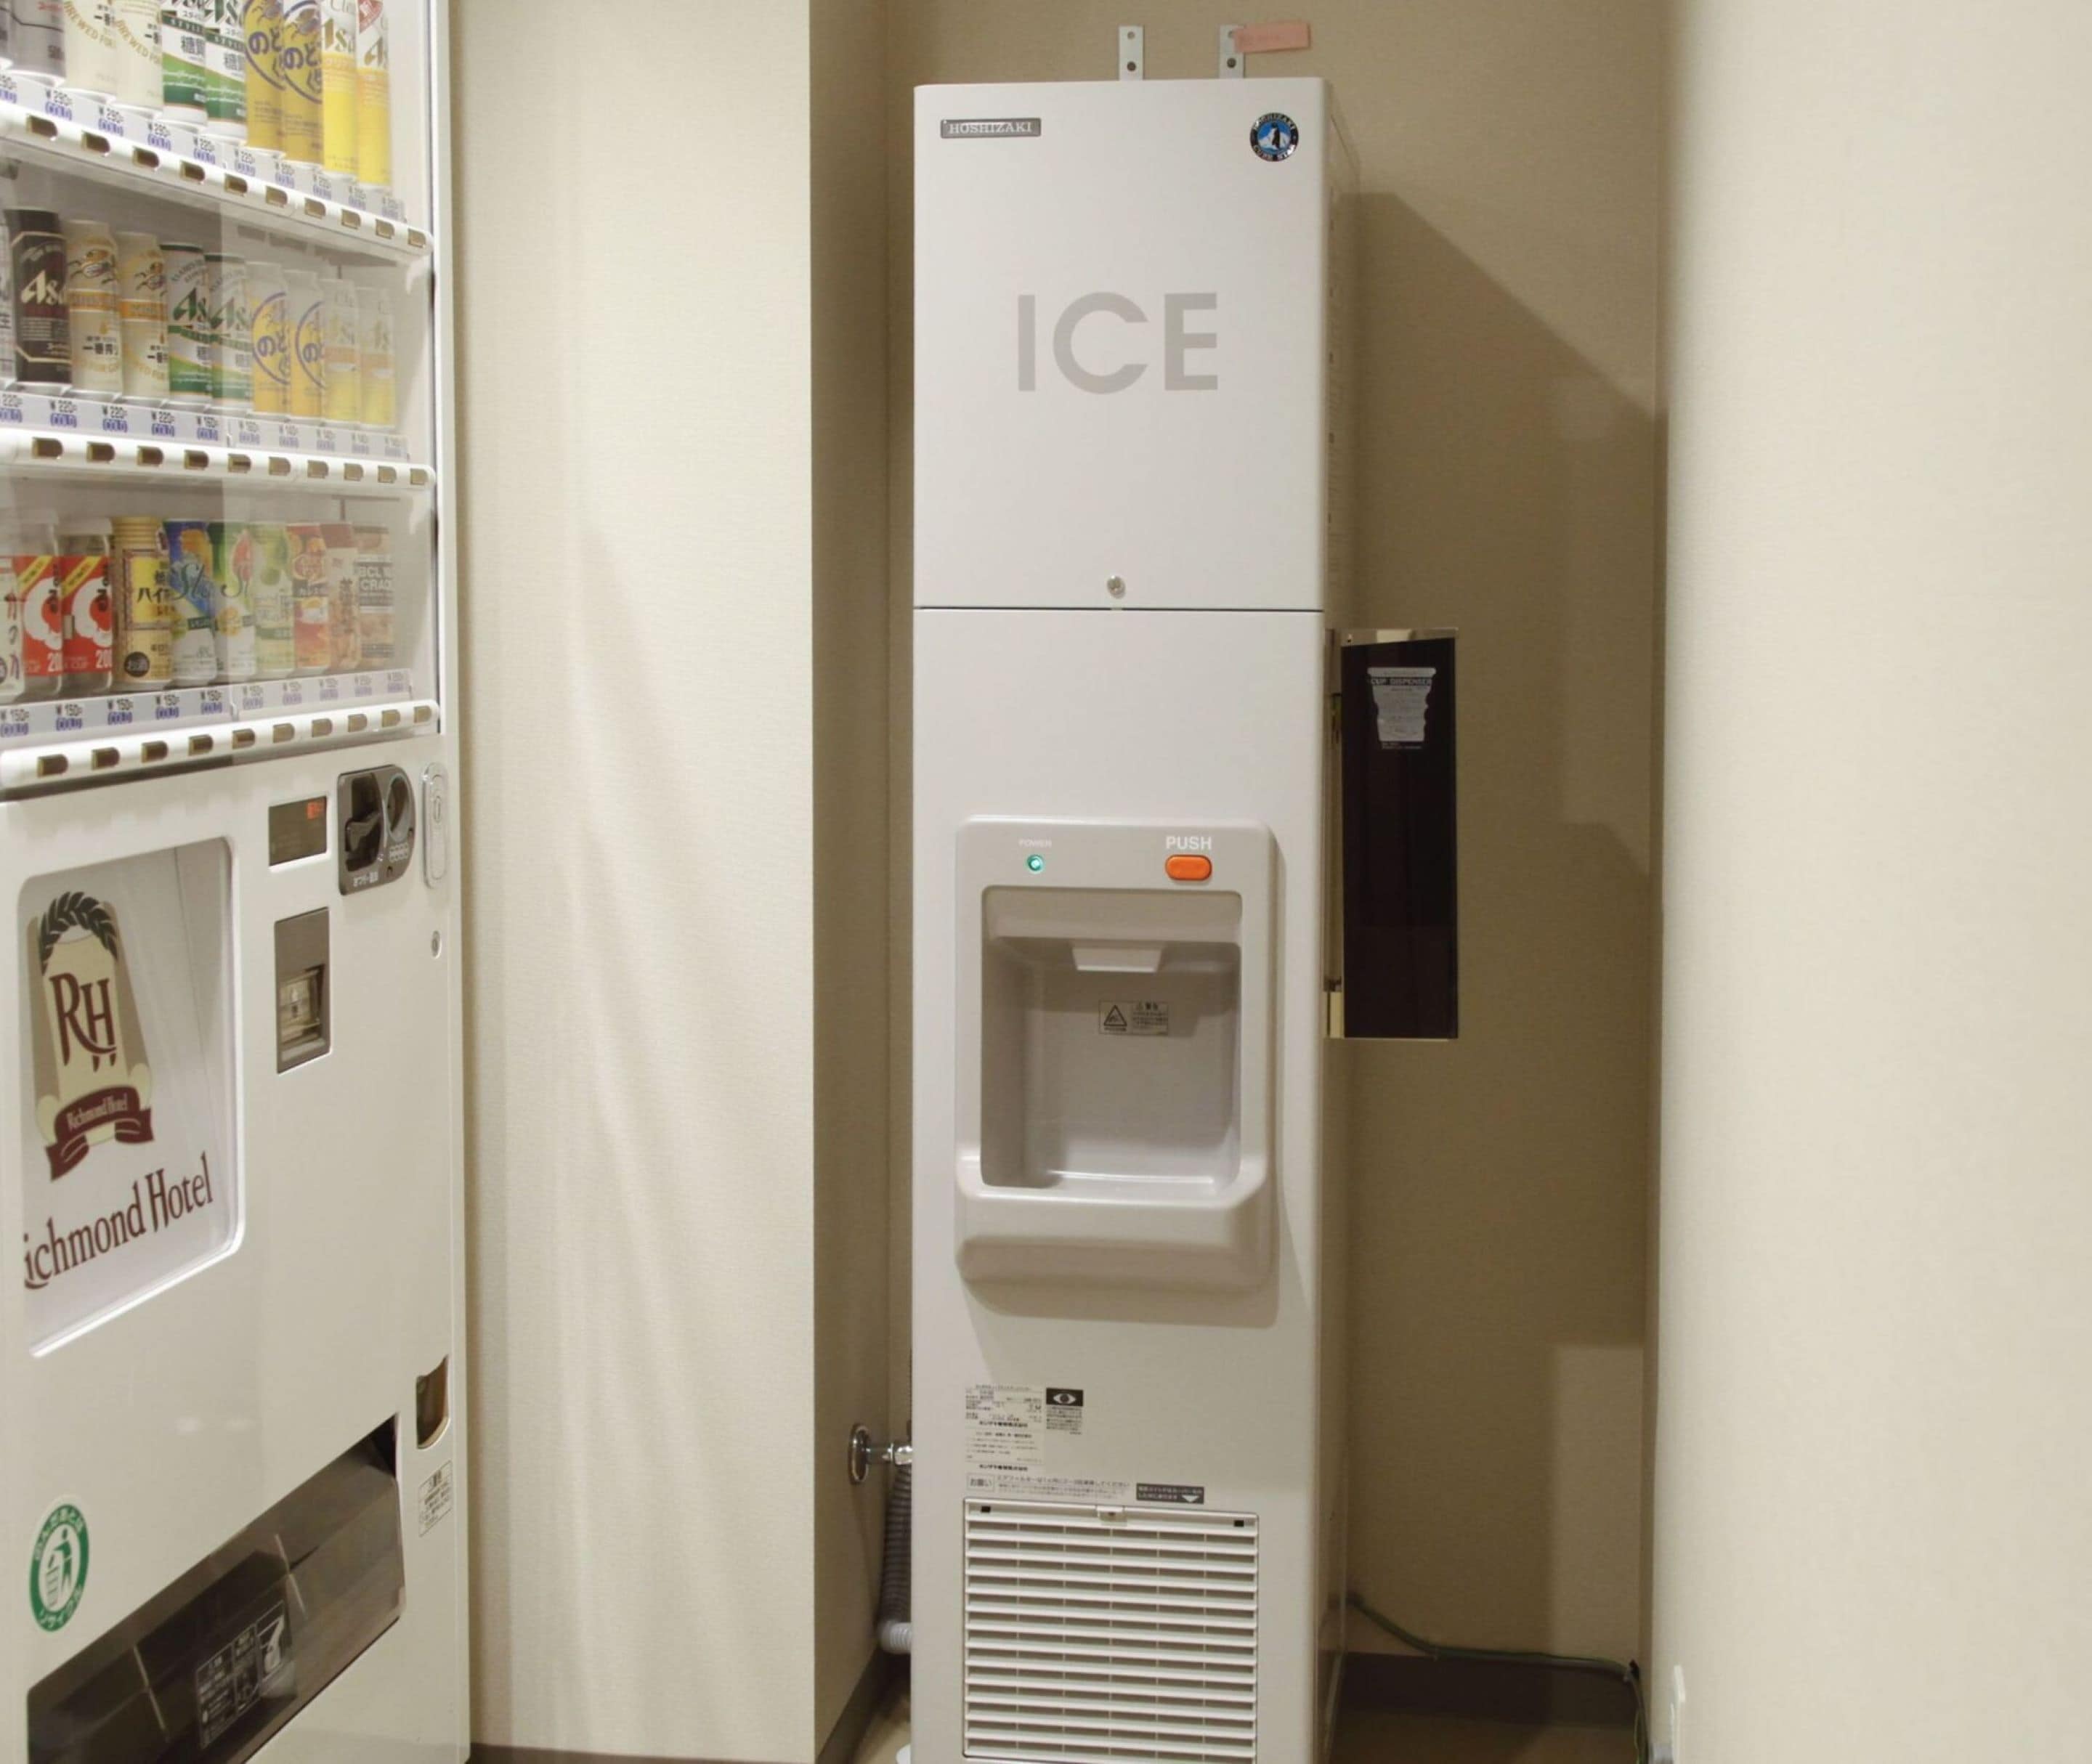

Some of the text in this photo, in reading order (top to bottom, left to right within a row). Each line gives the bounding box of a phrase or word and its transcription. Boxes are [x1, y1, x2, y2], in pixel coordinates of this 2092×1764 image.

[949, 121, 1033, 134] HOSHIZAKI
[1018, 292, 1218, 394] ICE
[1166, 836, 1212, 850] PUSH
[24, 1150, 214, 1290] ichmond Hotel
